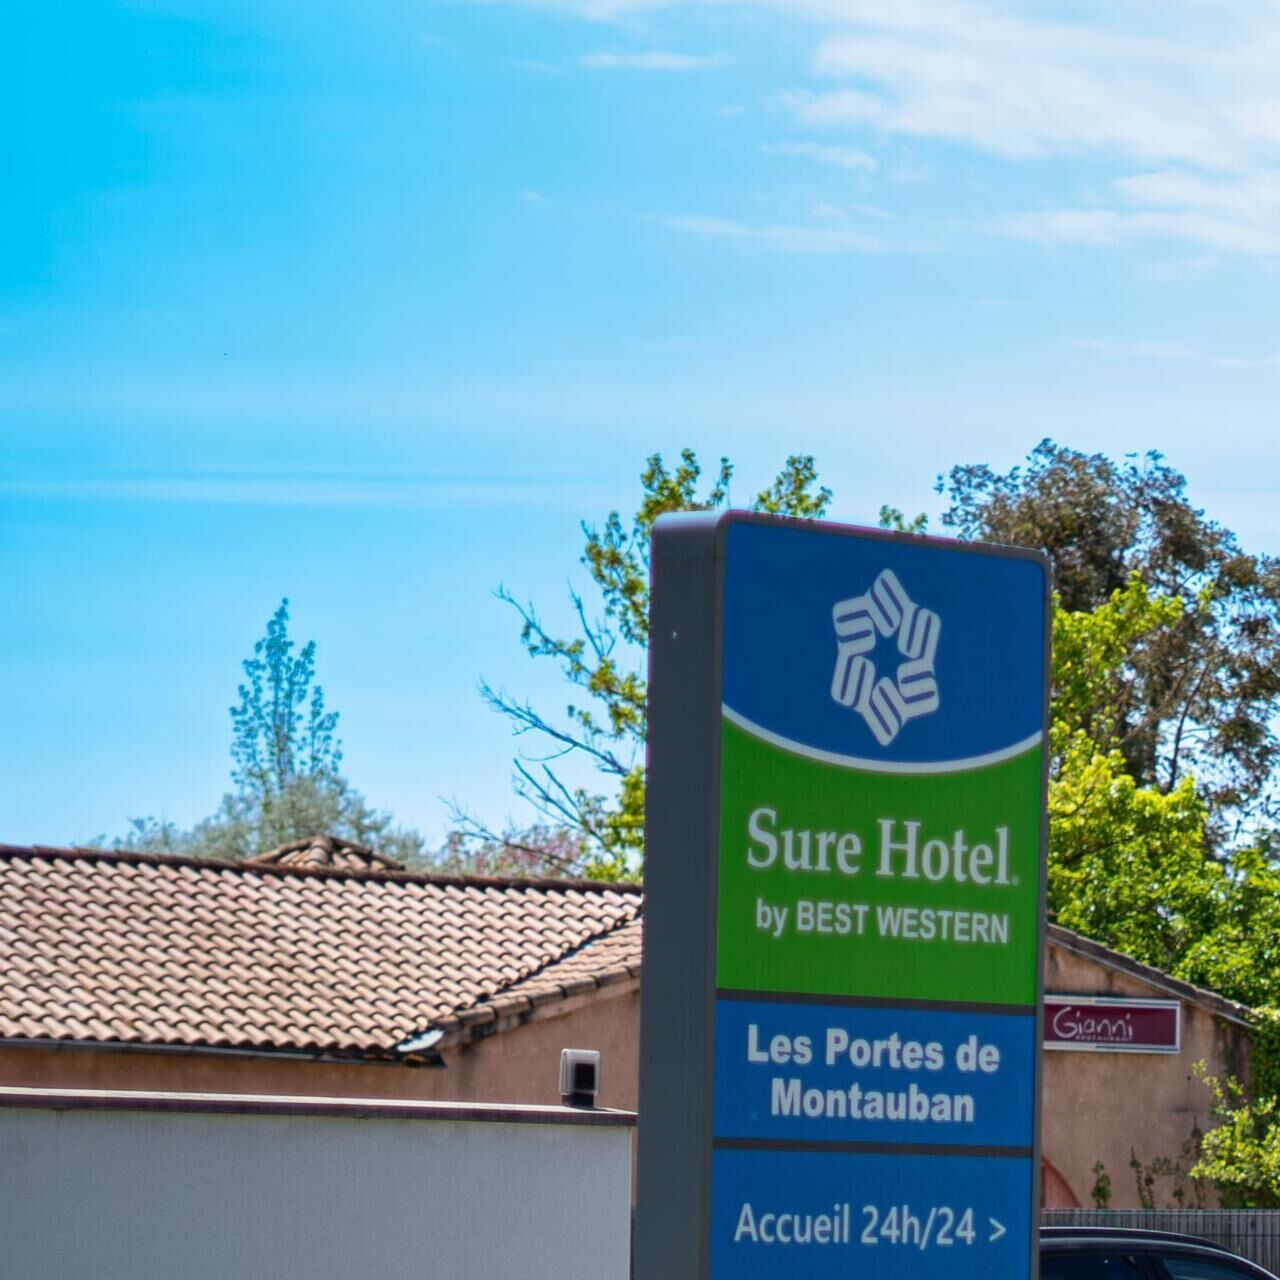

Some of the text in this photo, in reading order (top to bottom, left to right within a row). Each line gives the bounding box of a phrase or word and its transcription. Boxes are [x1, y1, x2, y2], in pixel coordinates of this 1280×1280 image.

[747, 807, 862, 874] Sure
[756, 897, 1008, 944] by BEST WESTERN
[1052, 1006, 1134, 1038] Gianni
[747, 1024, 1000, 1073] Les Portes de
[771, 1077, 975, 1122] Montauban
[734, 1203, 976, 1249] Accueil 24h/24
